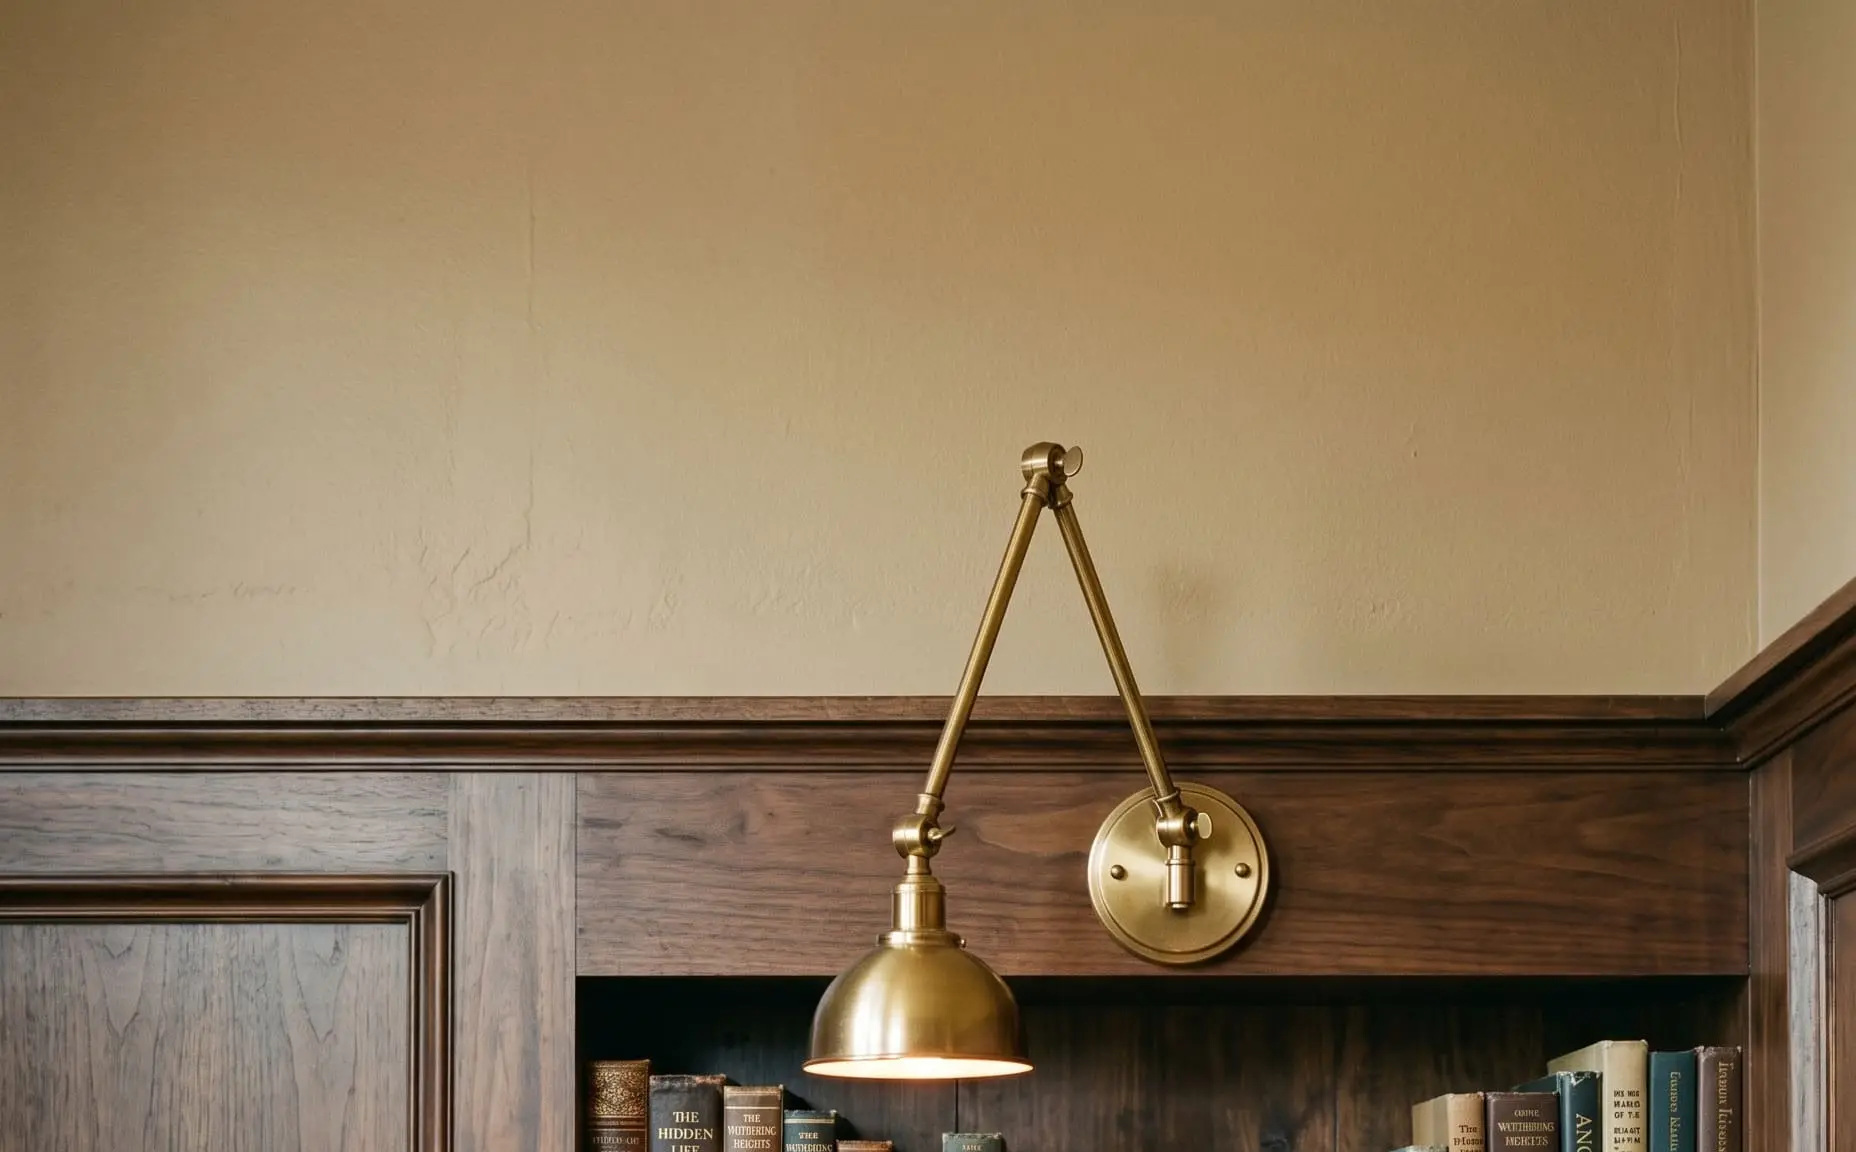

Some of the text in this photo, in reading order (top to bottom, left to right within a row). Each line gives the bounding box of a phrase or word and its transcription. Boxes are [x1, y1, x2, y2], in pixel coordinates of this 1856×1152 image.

[673, 1112, 699, 1123] THE
[743, 1114, 761, 1123] THE
[658, 1128, 714, 1140] HIDDEN
